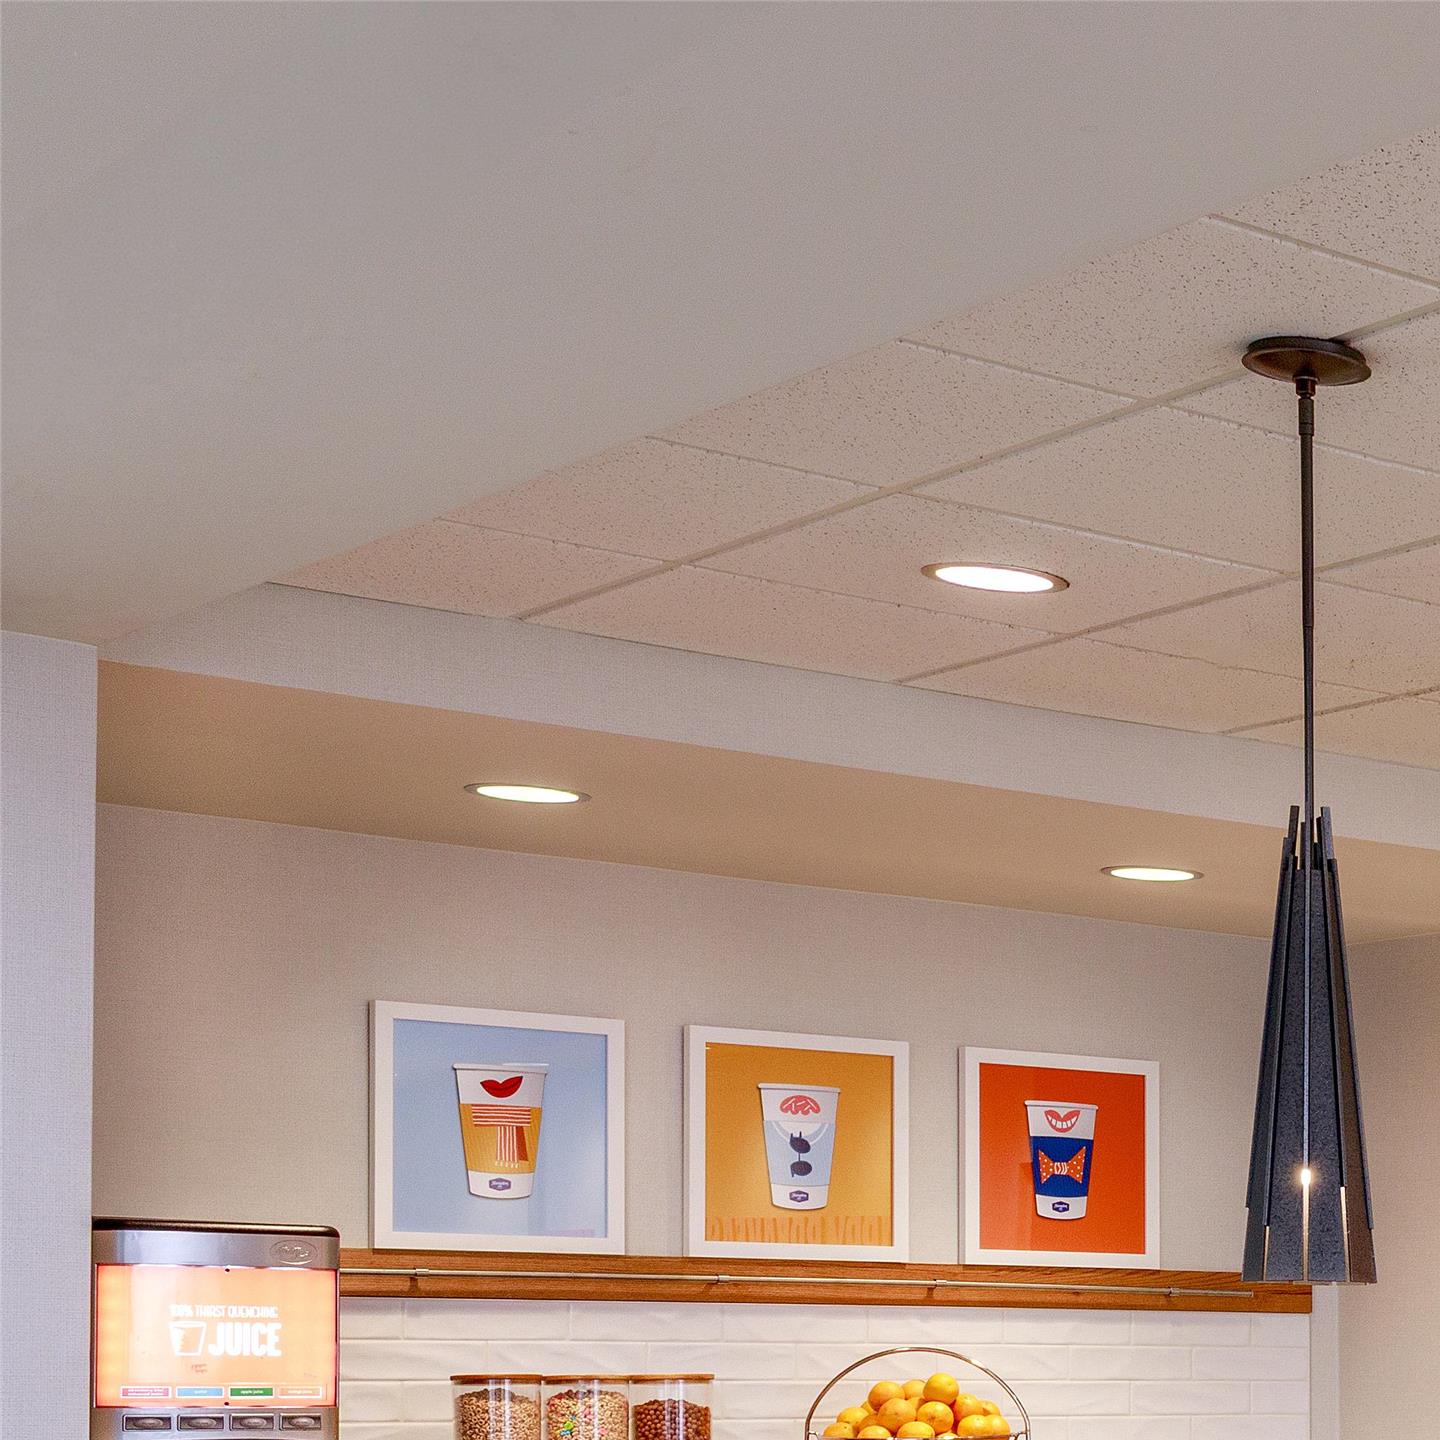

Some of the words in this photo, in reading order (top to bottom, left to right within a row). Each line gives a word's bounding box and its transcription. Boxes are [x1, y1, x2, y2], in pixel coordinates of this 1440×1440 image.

[195, 1304, 225, 1318] THIRST
[227, 1305, 279, 1319] QUENCHING
[207, 1321, 283, 1357] JUICE
